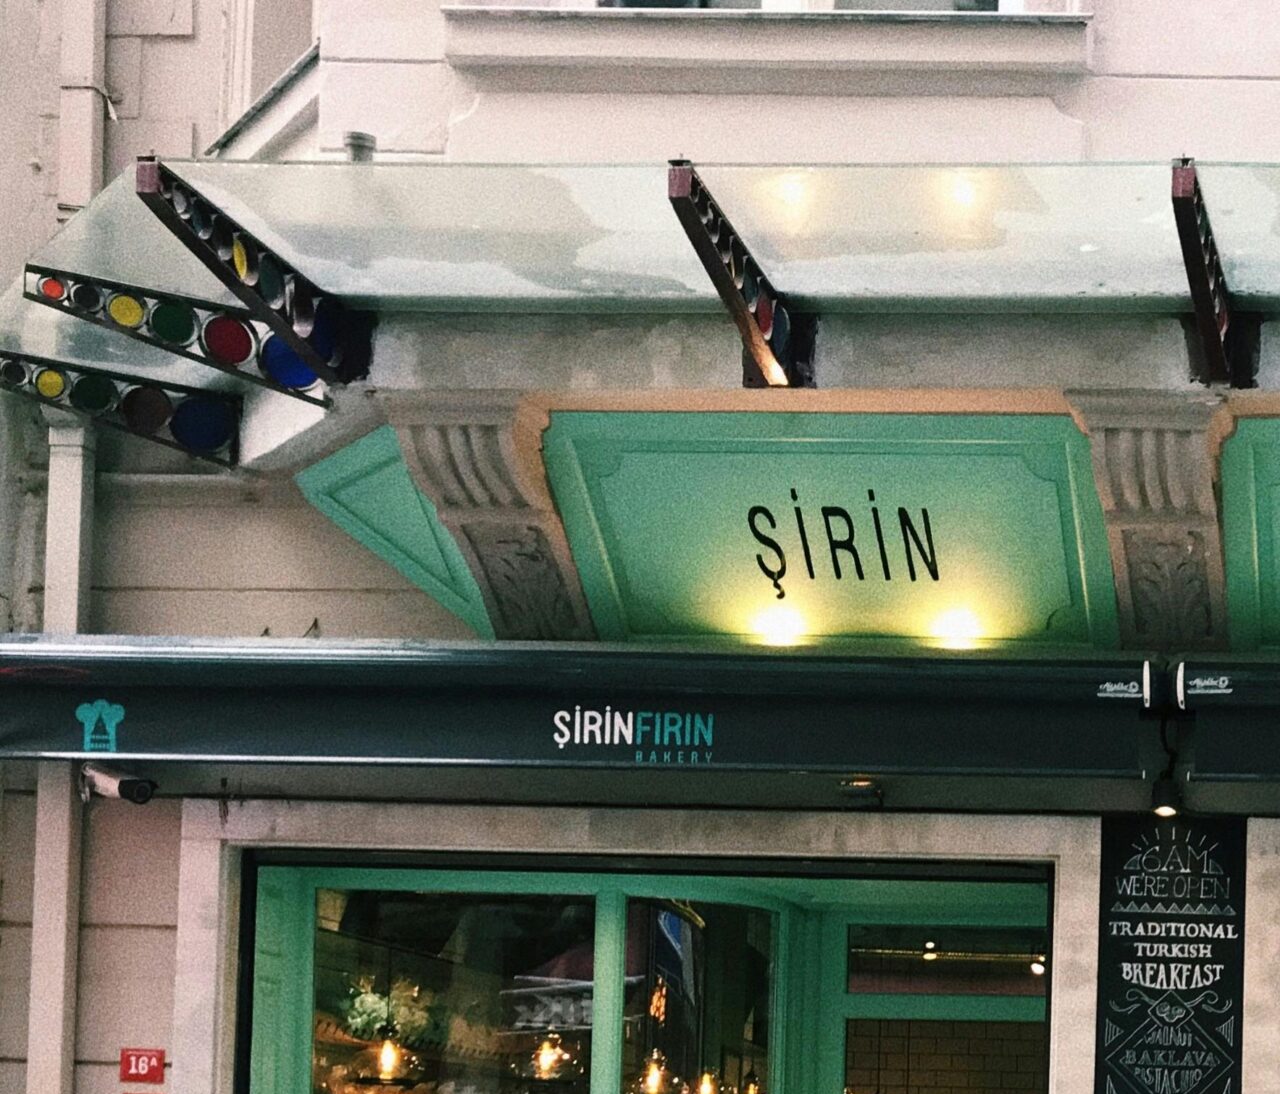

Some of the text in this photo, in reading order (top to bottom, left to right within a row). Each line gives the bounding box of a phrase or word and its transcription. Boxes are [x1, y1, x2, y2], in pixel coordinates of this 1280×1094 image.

[748, 488, 939, 599] ŞİRİN
[635, 751, 713, 764] BAKERY
[1116, 873, 1231, 899] WE'RE OPEN
[1109, 922, 1239, 939] TRADITIONAL
[1134, 943, 1212, 958] TURKISH
[1121, 962, 1225, 990] BREAKFAST
[1124, 1050, 1217, 1067] BAKLAVA
